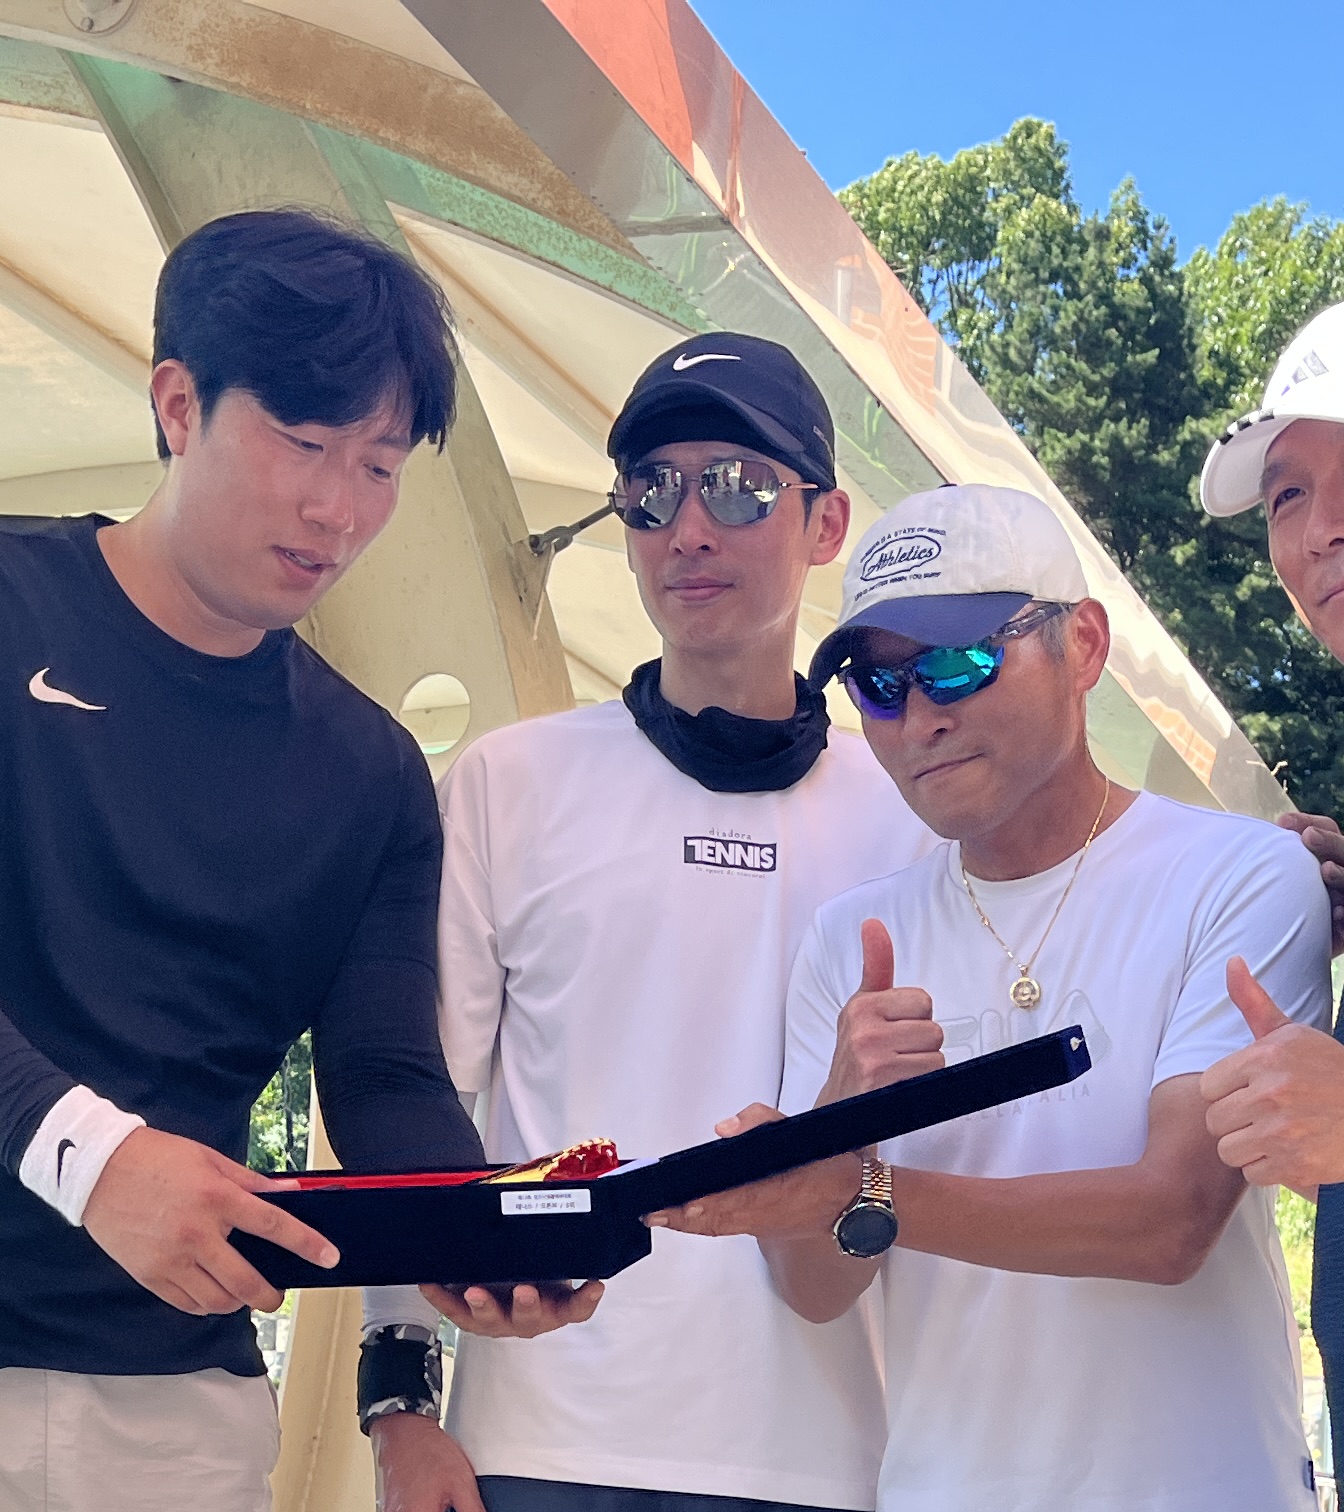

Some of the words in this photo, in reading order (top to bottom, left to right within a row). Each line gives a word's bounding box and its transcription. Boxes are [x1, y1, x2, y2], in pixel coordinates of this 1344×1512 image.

[864, 545, 934, 577] Athletics
[709, 827, 752, 840] diadora
[686, 839, 774, 869] TENNIS
